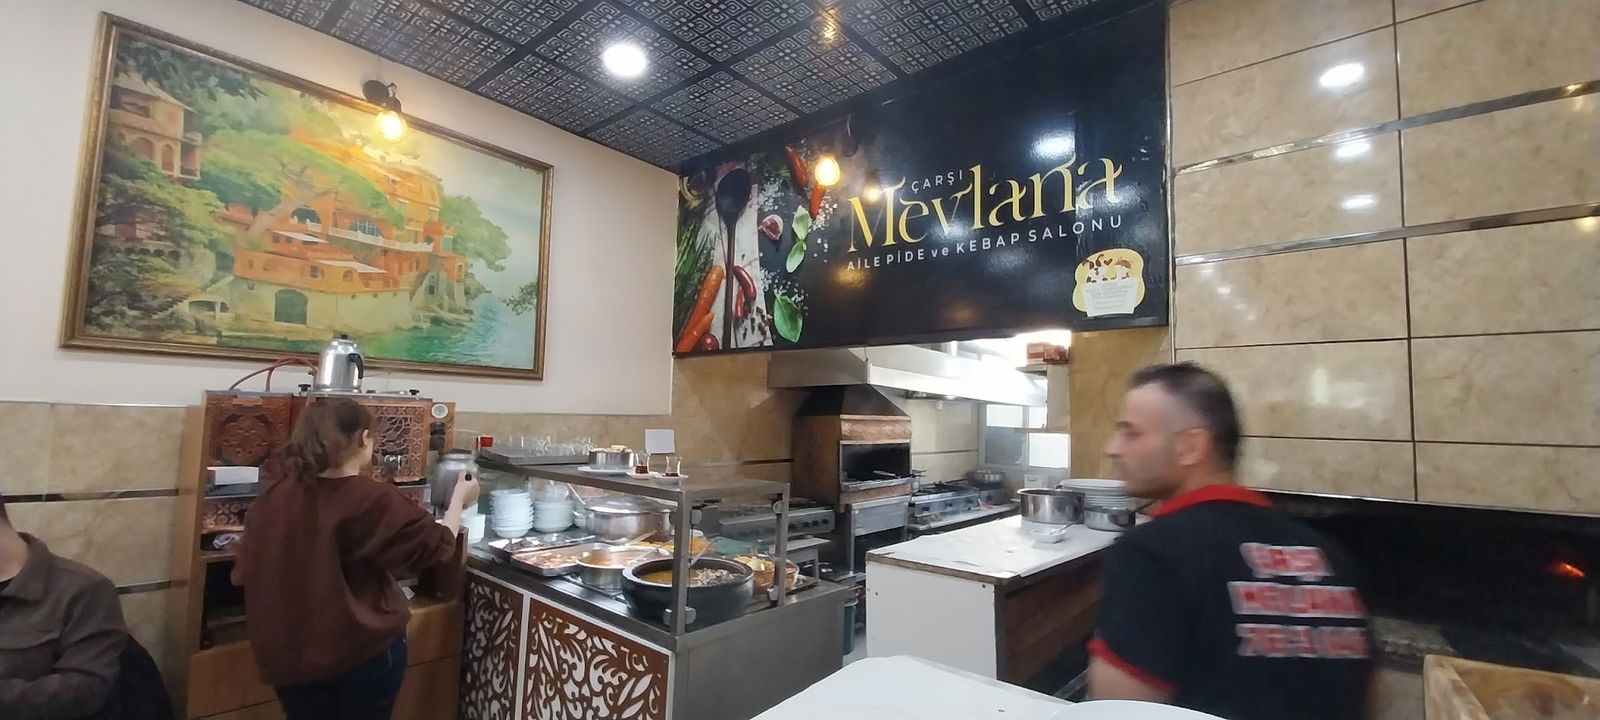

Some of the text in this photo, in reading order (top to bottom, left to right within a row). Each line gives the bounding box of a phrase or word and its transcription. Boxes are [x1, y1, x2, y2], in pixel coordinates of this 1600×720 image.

[847, 151, 1123, 253] Mevlana
[911, 169, 963, 195] ÇARŞI
[847, 214, 1122, 271] AİLE PİDE ve KEBAP SALONU
